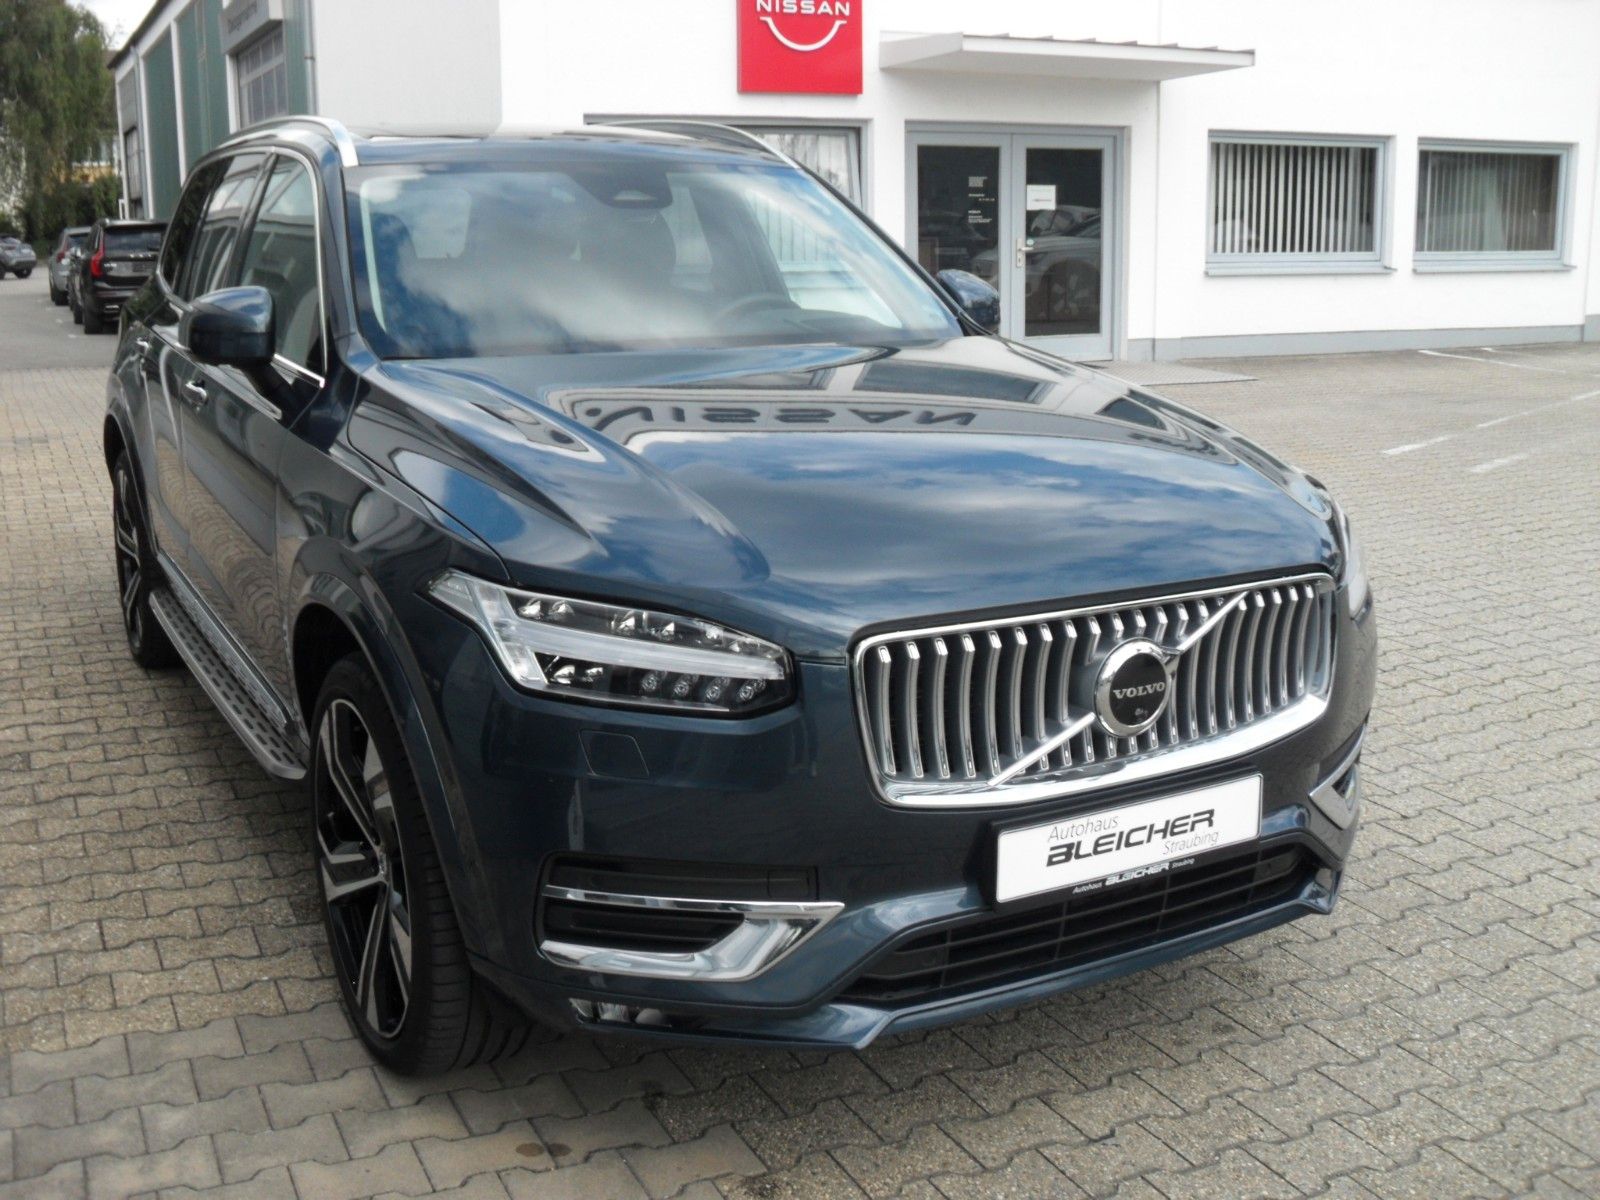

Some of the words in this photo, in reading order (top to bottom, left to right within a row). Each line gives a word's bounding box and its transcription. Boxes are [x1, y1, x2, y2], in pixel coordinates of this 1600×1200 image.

[756, 0, 850, 16] NISSAN
[1113, 682, 1166, 700] VOLVO
[1046, 808, 1215, 867] BLEICHER
[1047, 814, 1119, 842] Autohaus
[1163, 830, 1219, 855] Straubing
[1105, 862, 1170, 886] BLEICHER
